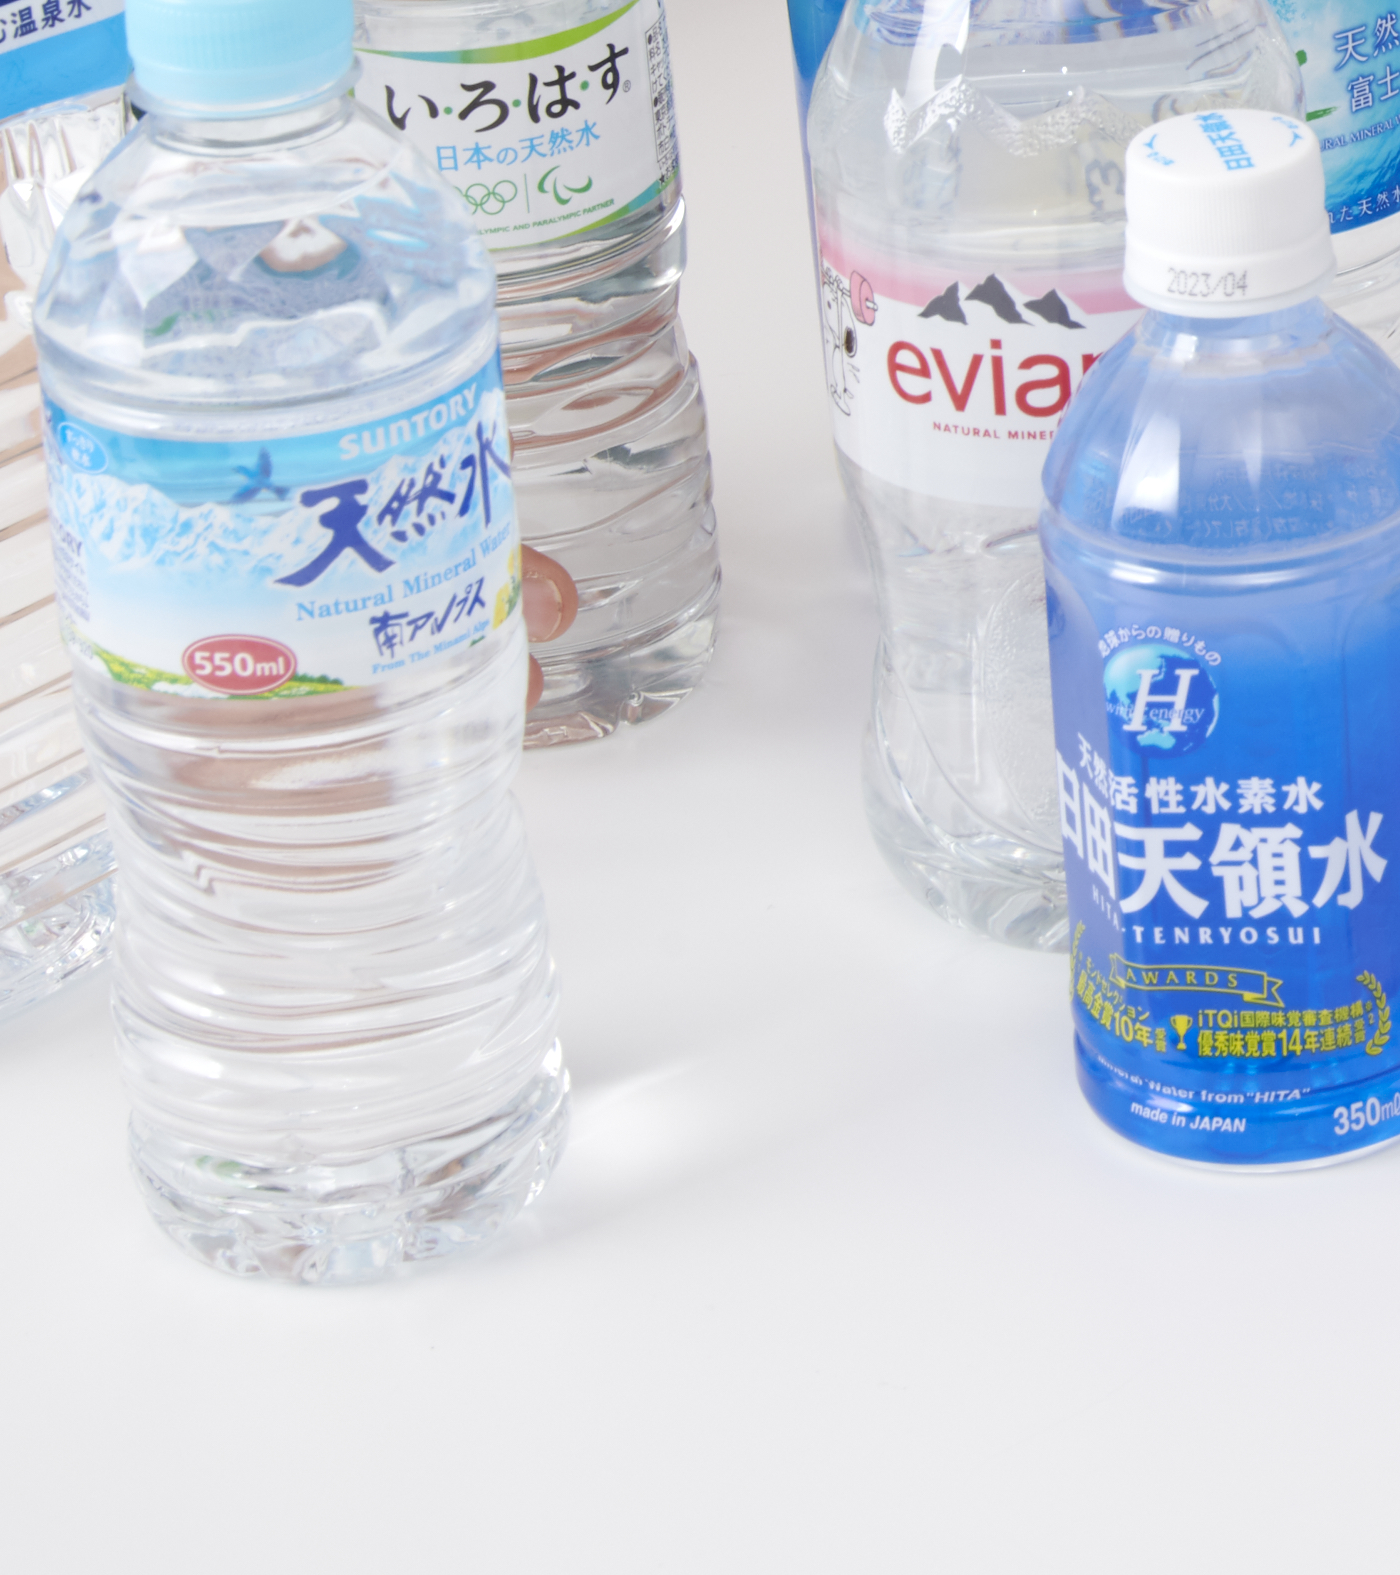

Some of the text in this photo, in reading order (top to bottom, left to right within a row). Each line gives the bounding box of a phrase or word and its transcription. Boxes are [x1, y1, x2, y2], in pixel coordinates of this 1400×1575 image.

[436, 119, 600, 172] 日本の天然水
[1350, 119, 1395, 144] MINERAL
[512, 198, 615, 232] AND PARALYMPIC PARTNER
[1167, 267, 1248, 298] 2023/04
[338, 382, 478, 460] SUNTORY
[932, 420, 1001, 440] NATURAL
[272, 419, 512, 588] 天然水
[296, 585, 394, 622] Natural
[401, 548, 477, 597] Mineral
[369, 577, 487, 659] 南アルプス
[193, 651, 286, 678] 550ml
[371, 656, 406, 675] From
[408, 648, 431, 664] The
[1122, 668, 1200, 732] H
[1077, 730, 1325, 815] 天然活性水素水
[1056, 749, 1389, 921] 日田天領水
[1085, 956, 1151, 1022] モンドセレクション
[1126, 969, 1239, 988] AWARDS
[1076, 969, 1154, 1048] 最高金賞10年
[1197, 1022, 1353, 1058] 優秀味覚賞14年連続
[1130, 1099, 1247, 1133] made in JAPAN
[1201, 1089, 1244, 1104] from
